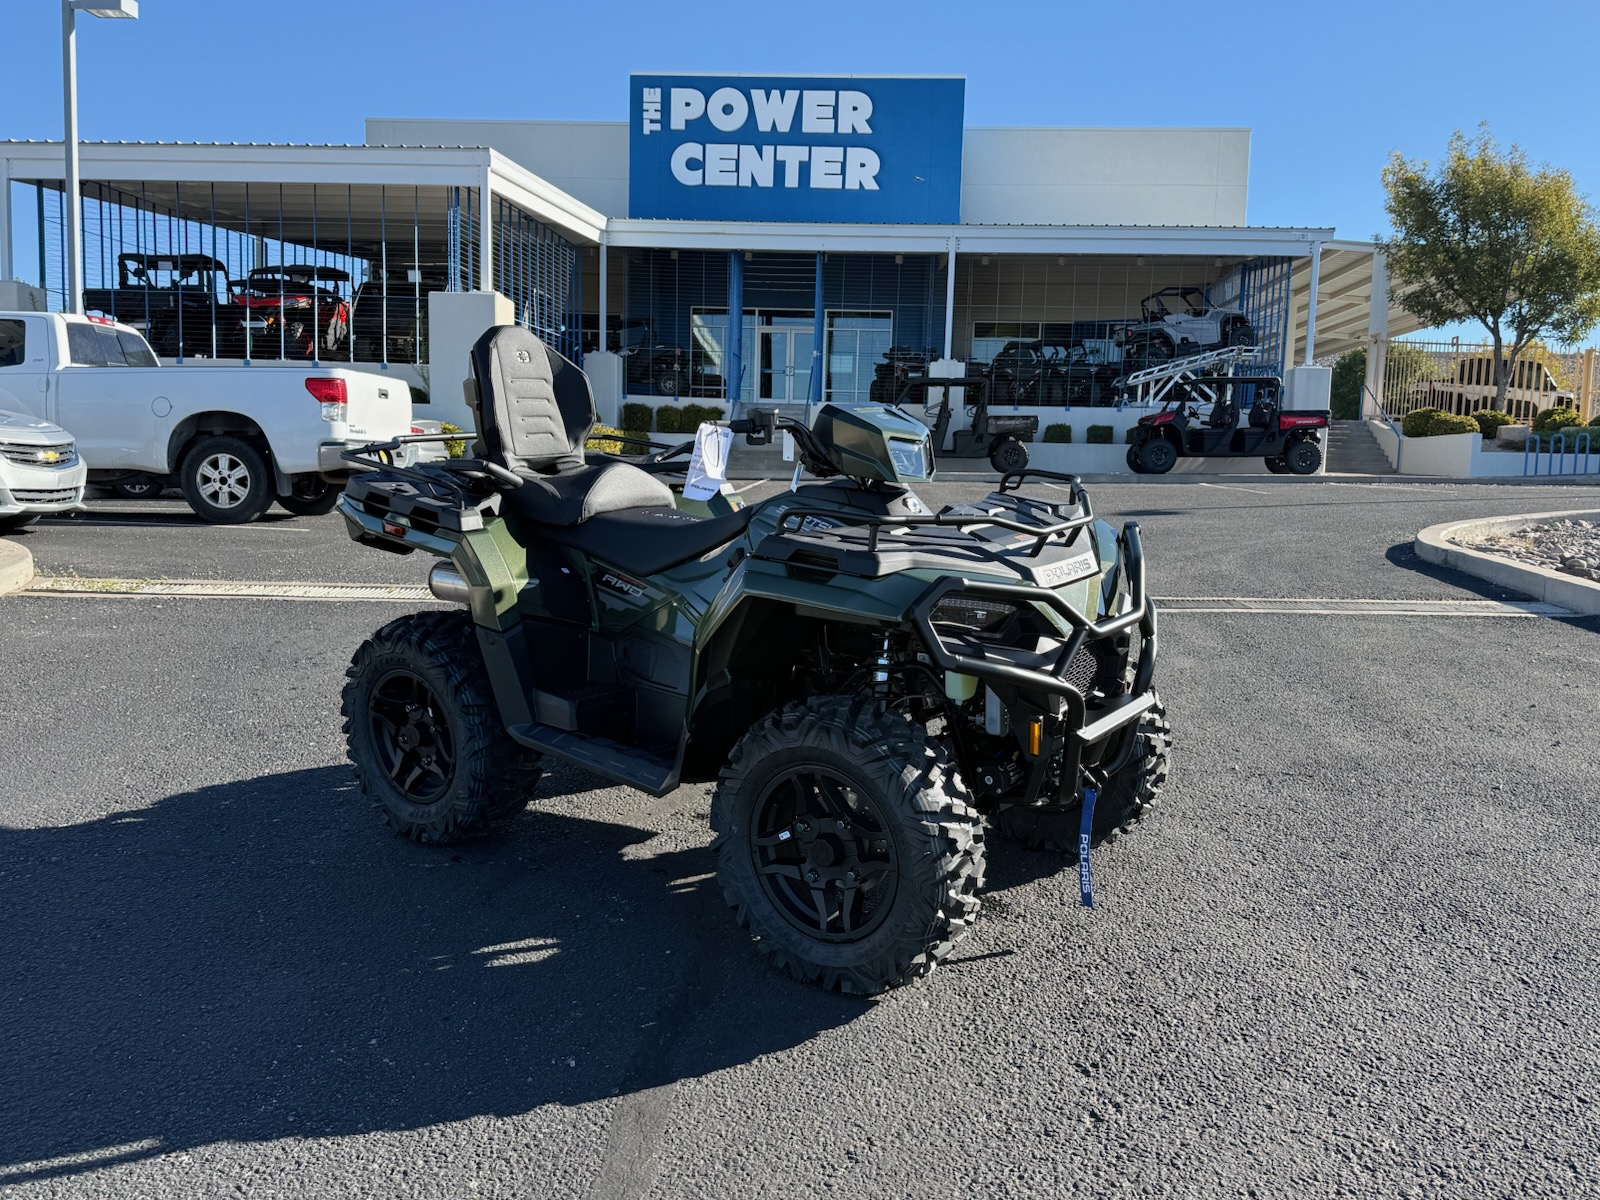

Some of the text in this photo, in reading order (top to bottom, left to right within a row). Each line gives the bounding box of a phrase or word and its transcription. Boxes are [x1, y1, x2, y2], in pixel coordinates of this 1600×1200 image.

[642, 87, 662, 135] THE
[669, 87, 874, 135] POWER
[669, 142, 881, 190] CENTER
[1043, 558, 1092, 582] POLARIS
[1080, 833, 1091, 893] POLARIS
